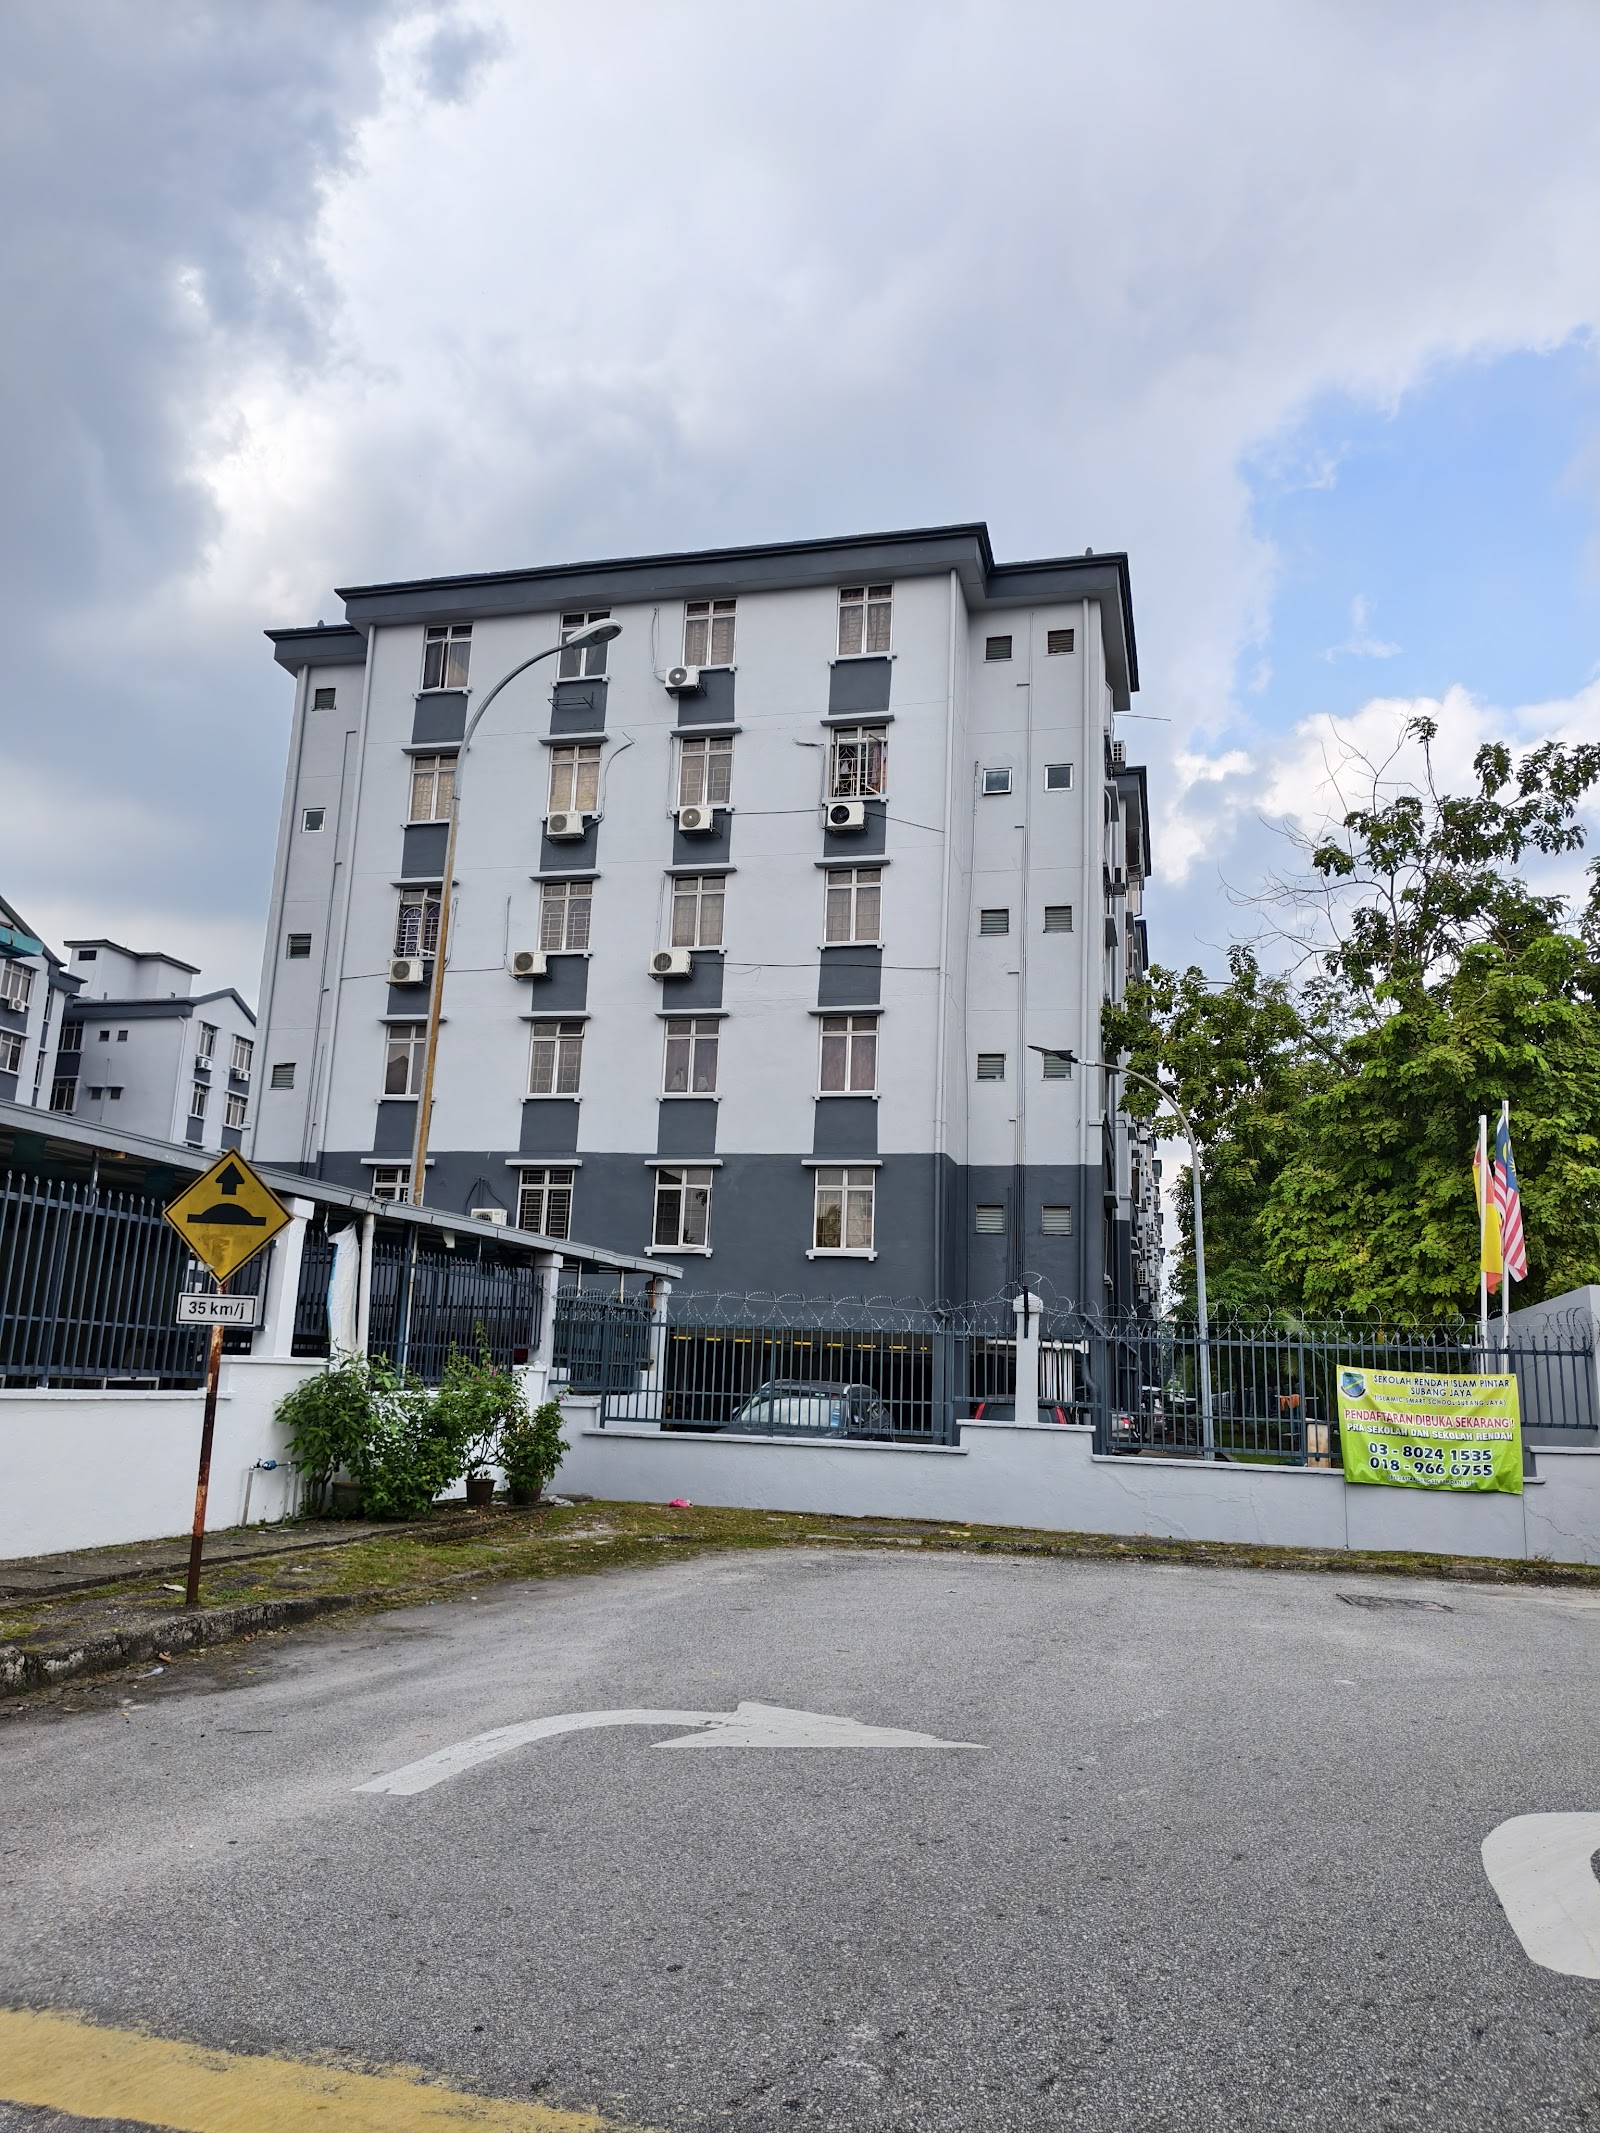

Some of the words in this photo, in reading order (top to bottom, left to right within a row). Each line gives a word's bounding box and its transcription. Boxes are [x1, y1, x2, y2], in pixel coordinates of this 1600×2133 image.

[188, 1301, 206, 1315] 35
[210, 1301, 245, 1320] km/j
[1373, 1374, 1411, 1385] SEKOLAH
[1414, 1378, 1448, 1387] RENDAH
[1450, 1379, 1477, 1388] ISLAM
[1479, 1379, 1510, 1388] PINTAR
[1410, 1387, 1446, 1397] SUBANG
[1449, 1389, 1472, 1397] JAYA
[1345, 1409, 1413, 1425] PENDAFTARAN
[1415, 1414, 1453, 1428] DIBUKA
[1347, 1423, 1365, 1432] PRA
[1366, 1425, 1408, 1437] SEKOLAH
[1411, 1429, 1430, 1438] DAN
[1432, 1430, 1473, 1441] SEKOLAH
[1475, 1432, 1514, 1441] RENDAH
[1369, 1442, 1388, 1455] 03
[1402, 1446, 1444, 1460] 8024
[1451, 1449, 1492, 1462] 1535
[1370, 1457, 1400, 1471] 018
[1414, 1462, 1445, 1475] 966
[1450, 1464, 1493, 1476] 6755
